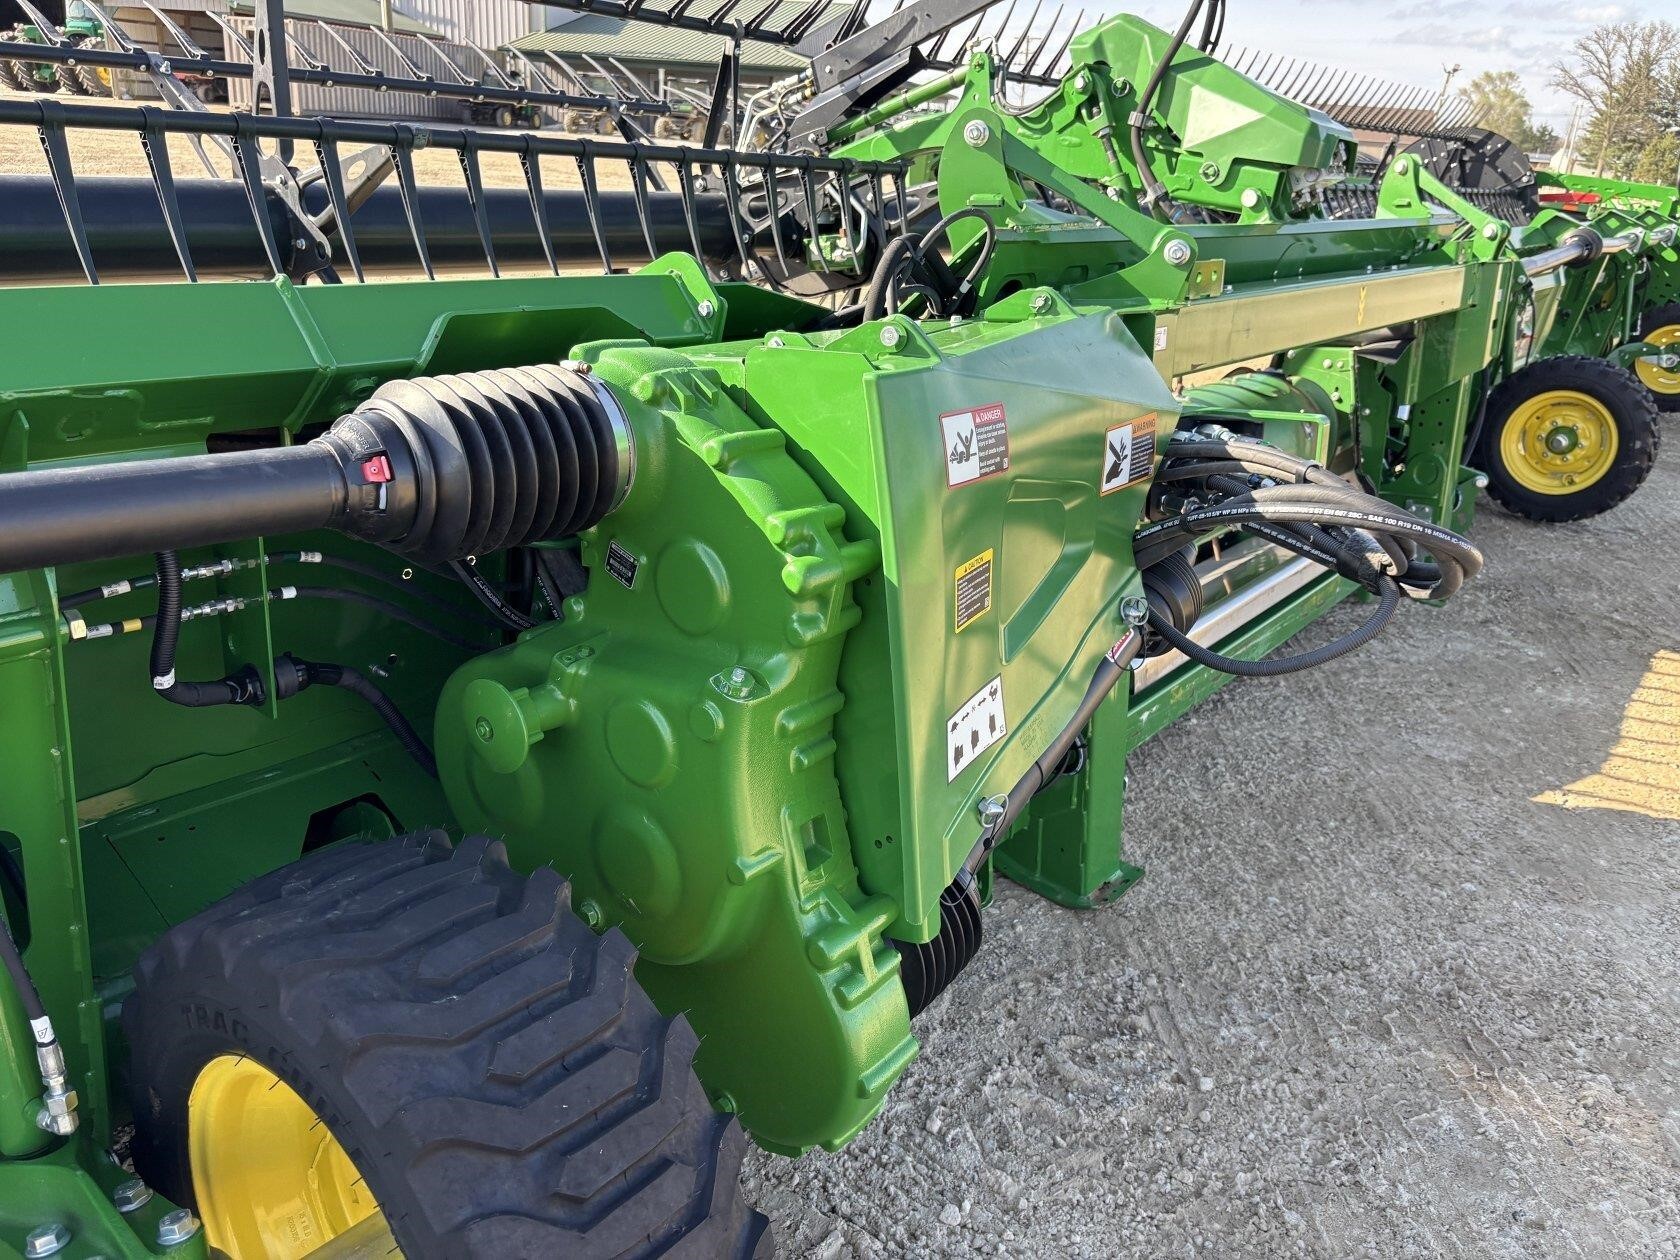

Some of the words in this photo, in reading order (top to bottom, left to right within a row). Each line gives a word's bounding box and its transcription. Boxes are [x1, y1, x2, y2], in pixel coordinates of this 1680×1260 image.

[980, 410, 1002, 421] DANGER
[1136, 418, 1156, 432] WARNING
[1323, 508, 1335, 516] EN
[1368, 514, 1384, 523] SAE
[1384, 517, 1397, 525] 100
[1397, 520, 1411, 529] R19
[1411, 524, 1423, 532] DN
[181, 1003, 249, 1042] TRAC
